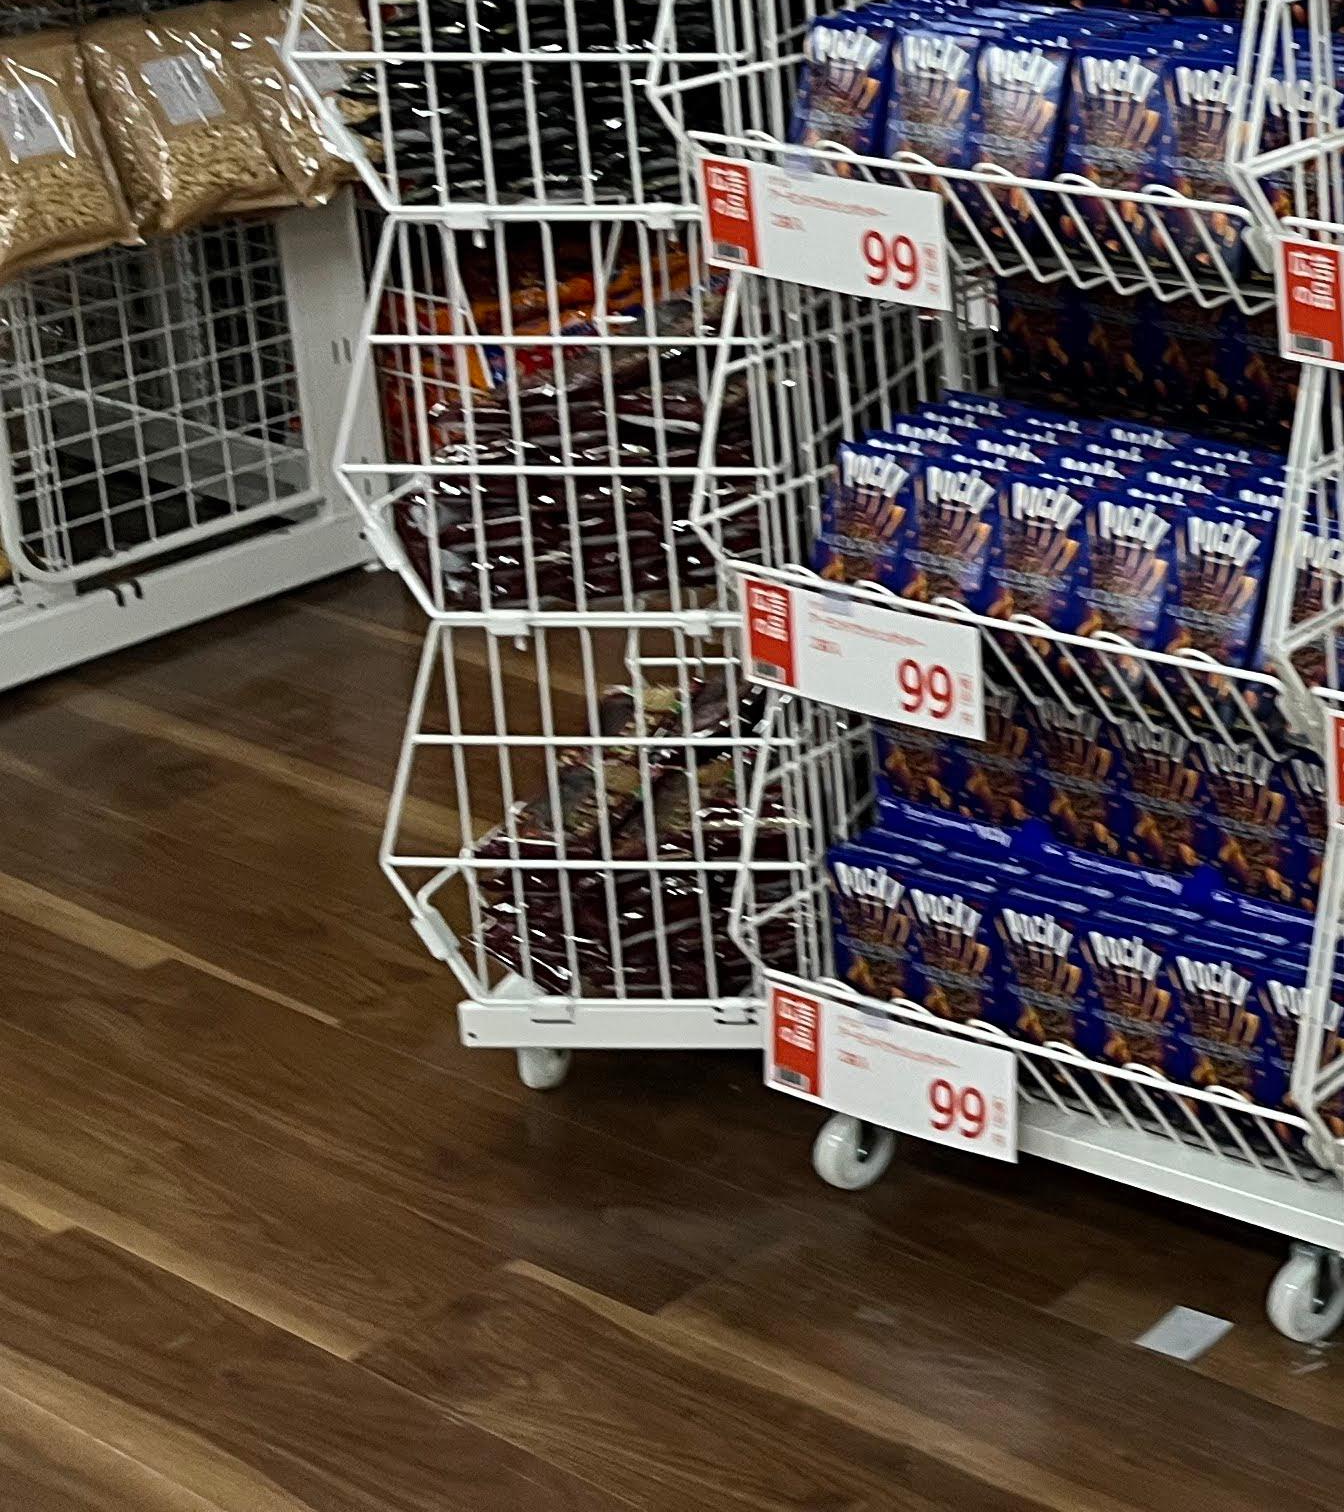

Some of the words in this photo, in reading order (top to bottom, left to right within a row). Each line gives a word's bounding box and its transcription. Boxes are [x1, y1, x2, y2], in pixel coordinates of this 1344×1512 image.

[863, 228, 920, 292] 99
[841, 451, 909, 497] POCKY
[925, 466, 995, 513] POCKY
[1012, 480, 1082, 530] POCKY
[1099, 498, 1170, 548] POCKY
[1187, 515, 1260, 566] POCKY
[897, 657, 954, 720] 99
[928, 1077, 987, 1140] 99
